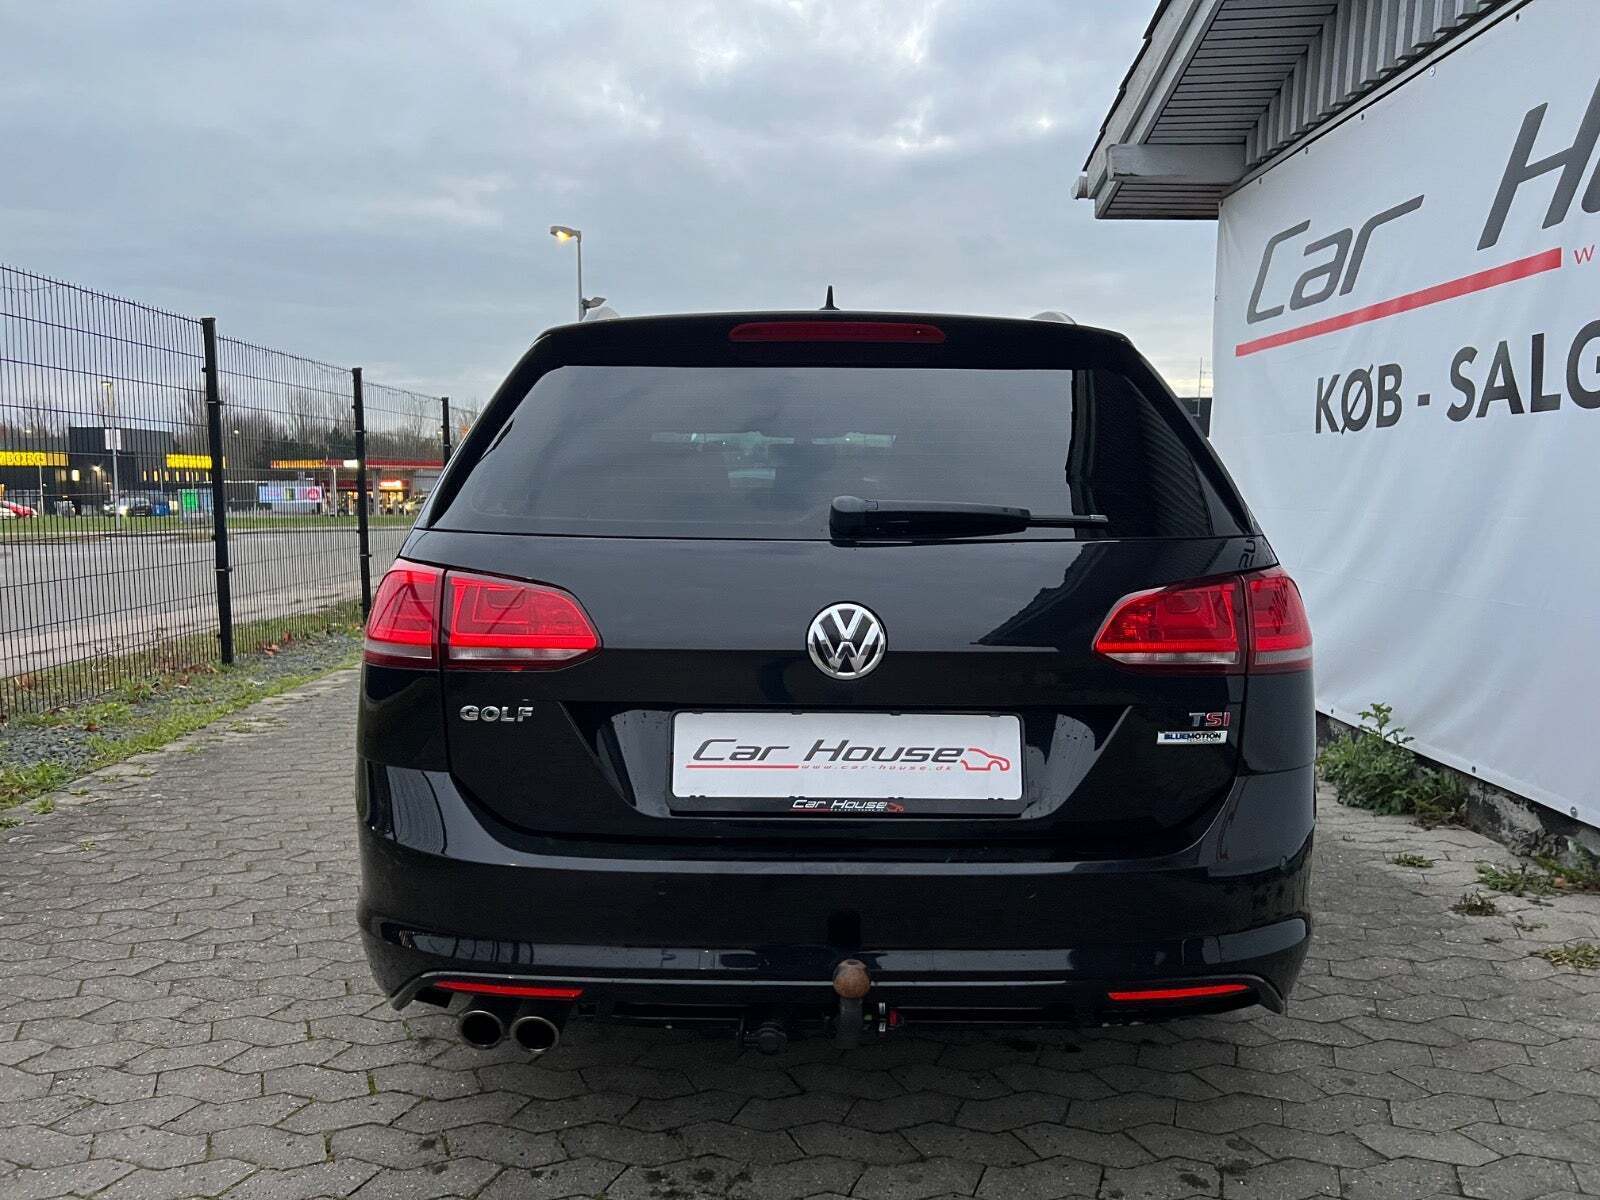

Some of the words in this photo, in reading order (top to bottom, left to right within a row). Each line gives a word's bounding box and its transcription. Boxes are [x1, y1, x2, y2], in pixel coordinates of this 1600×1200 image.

[1246, 194, 1425, 325] Car
[1315, 363, 1402, 435] KØB
[460, 705, 534, 722] GOLF
[1164, 732, 1221, 740] BLUEMOTION
[692, 738, 790, 761] Car
[803, 739, 965, 763] House
[801, 763, 953, 771] www.car-house.dk
[792, 799, 827, 809] Car
[831, 799, 888, 809] House
